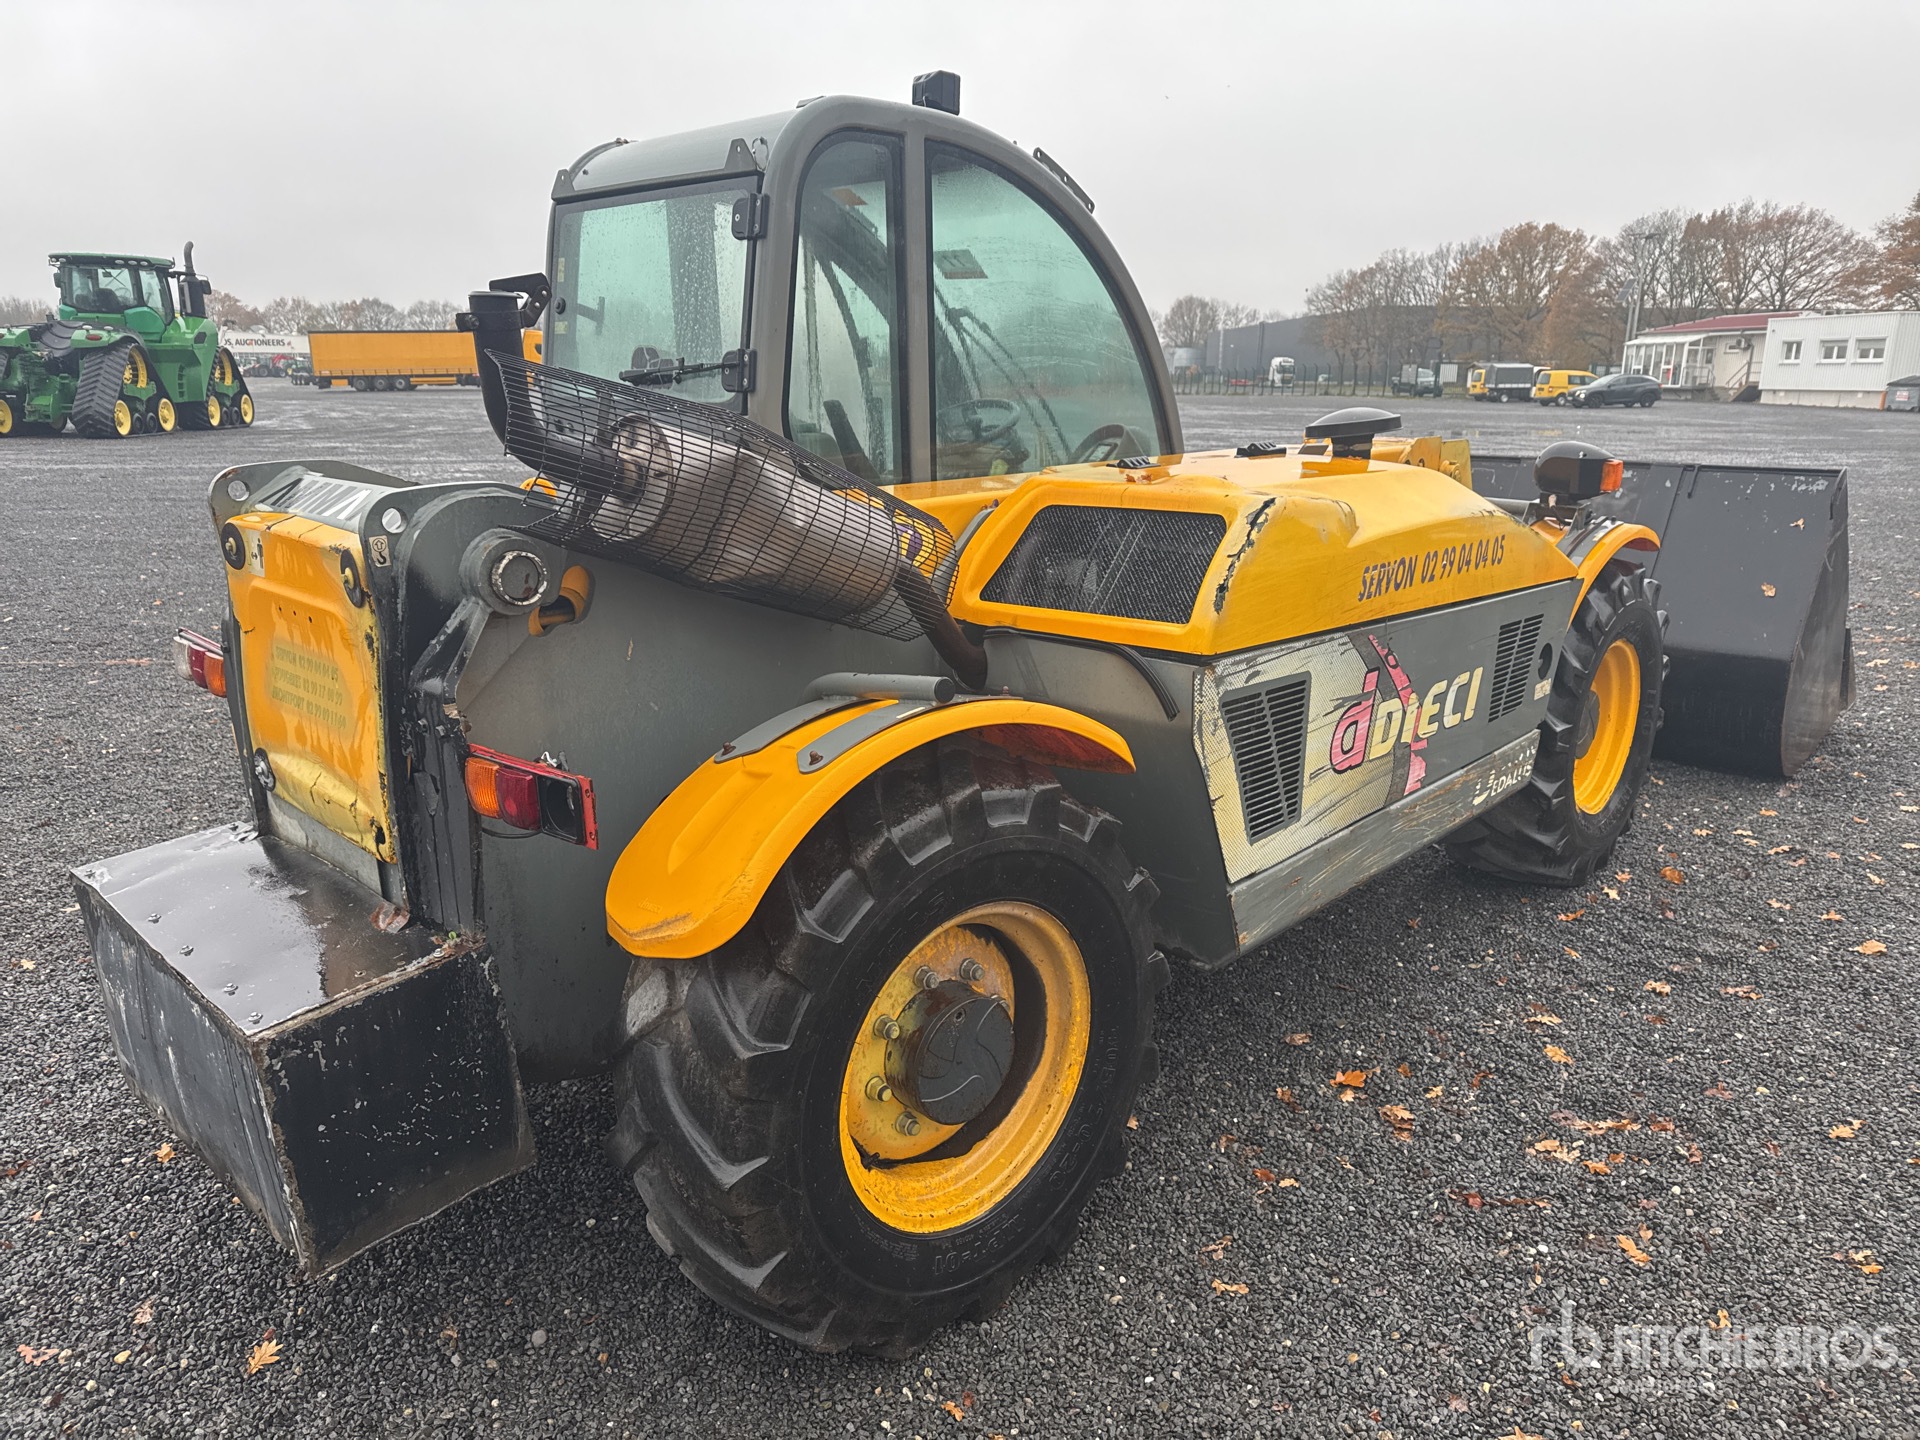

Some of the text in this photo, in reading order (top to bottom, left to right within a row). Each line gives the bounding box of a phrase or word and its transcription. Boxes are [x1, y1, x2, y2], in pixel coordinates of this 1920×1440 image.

[1358, 534, 1505, 602] SERVON 02 99 04 04 05
